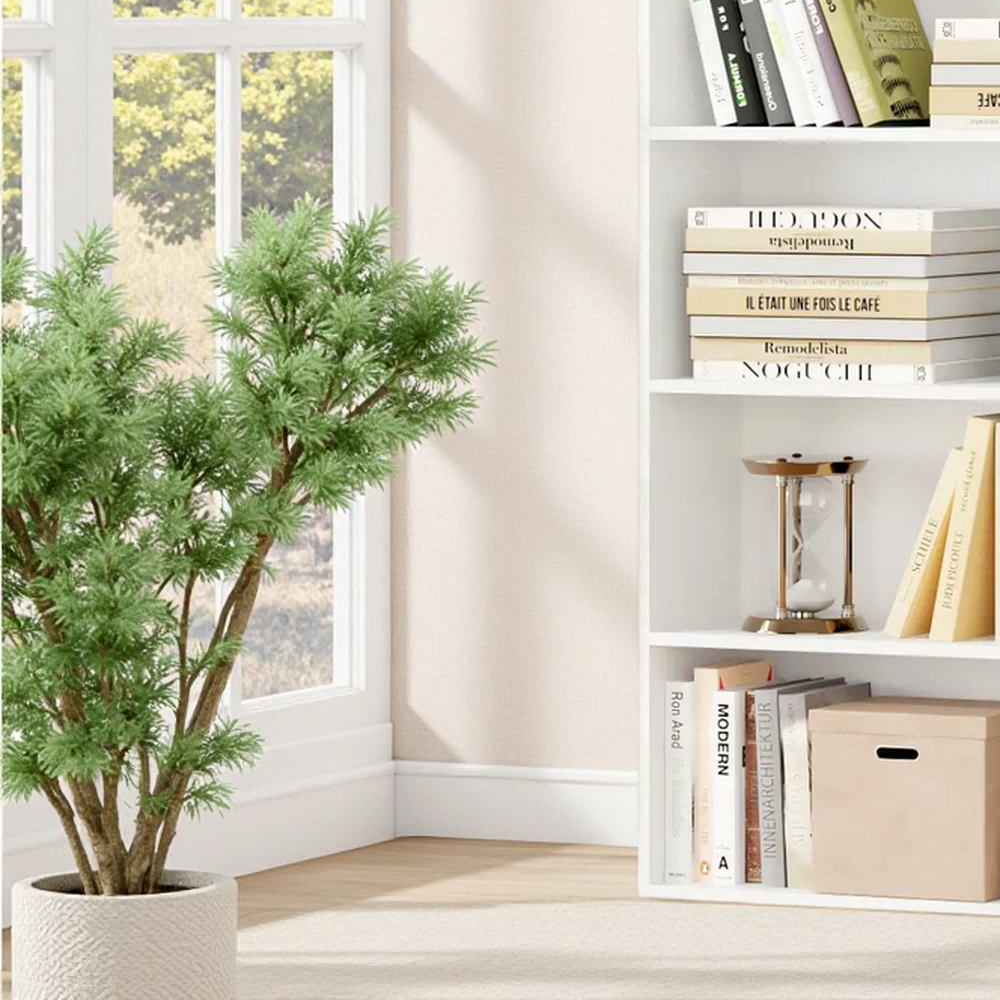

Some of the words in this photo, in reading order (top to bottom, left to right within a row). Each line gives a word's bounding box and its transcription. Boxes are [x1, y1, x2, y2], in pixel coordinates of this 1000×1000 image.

[749, 211, 882, 229] NOGUCHI
[769, 236, 854, 250] Remodelista
[746, 295, 756, 310] IL
[758, 294, 786, 311] ÉTAIT
[789, 296, 810, 311] UNE
[813, 297, 837, 311] FOIS
[839, 297, 851, 311] LE
[853, 296, 880, 312] CAFÉ
[764, 342, 847, 355] Remodelista
[742, 361, 872, 380] NOGUCHI
[912, 518, 938, 573] SCHIELE
[946, 532, 964, 582] PICOULT
[671, 691, 683, 716] Ron
[671, 719, 683, 749] Arad
[717, 703, 729, 776] MODERN
[758, 702, 777, 859] INNENARCHITEKTUR
[718, 856, 729, 870] A
